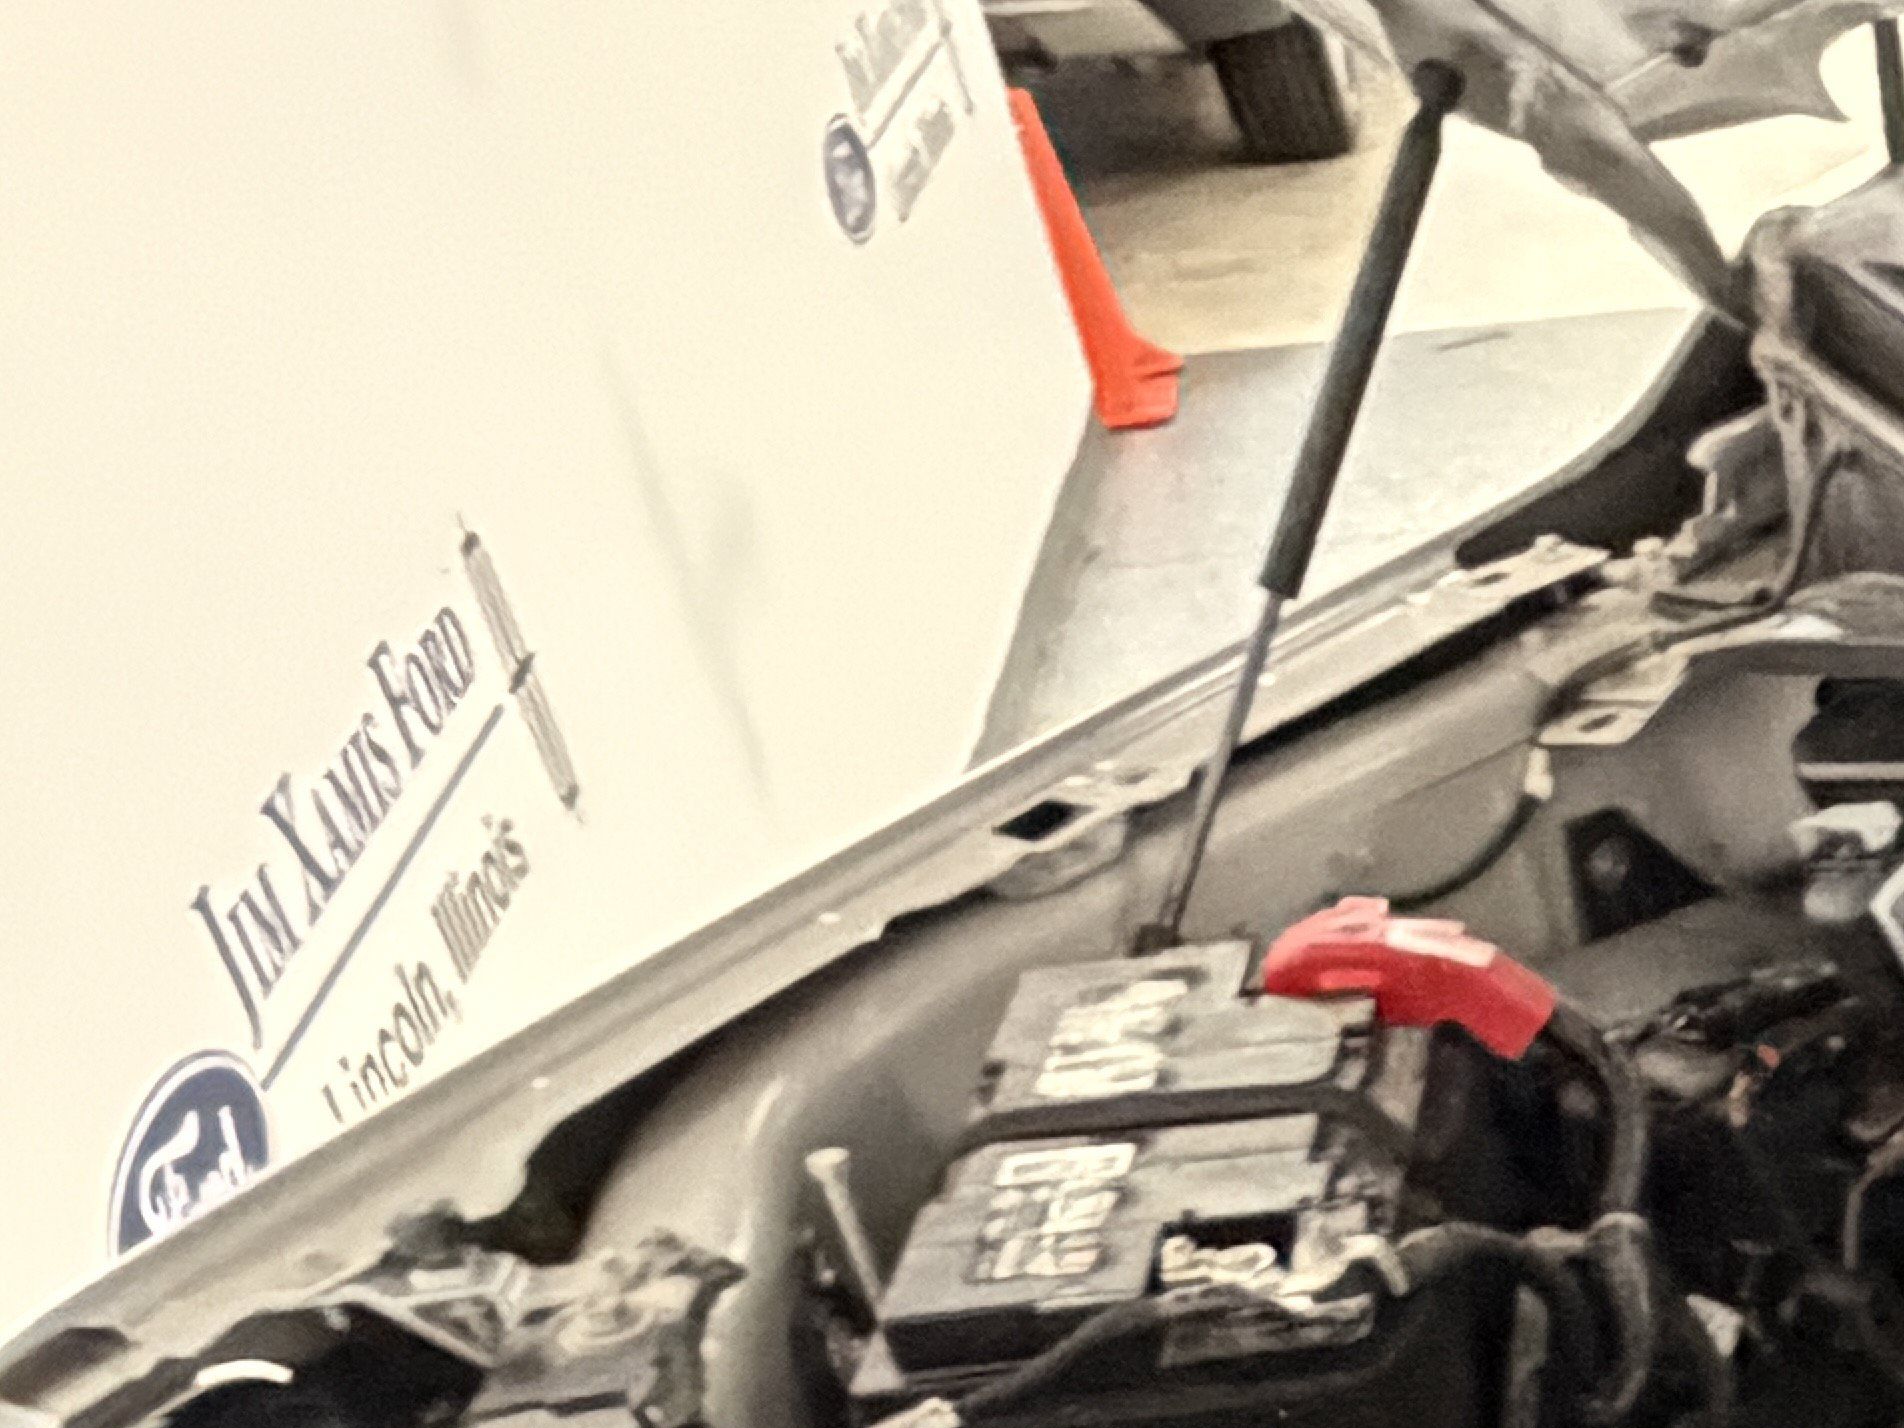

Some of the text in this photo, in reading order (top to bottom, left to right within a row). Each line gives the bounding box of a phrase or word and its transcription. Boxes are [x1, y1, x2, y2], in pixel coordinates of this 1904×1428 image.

[190, 606, 475, 1049] JIM XAMIS FORD
[431, 812, 531, 984] Illinois
